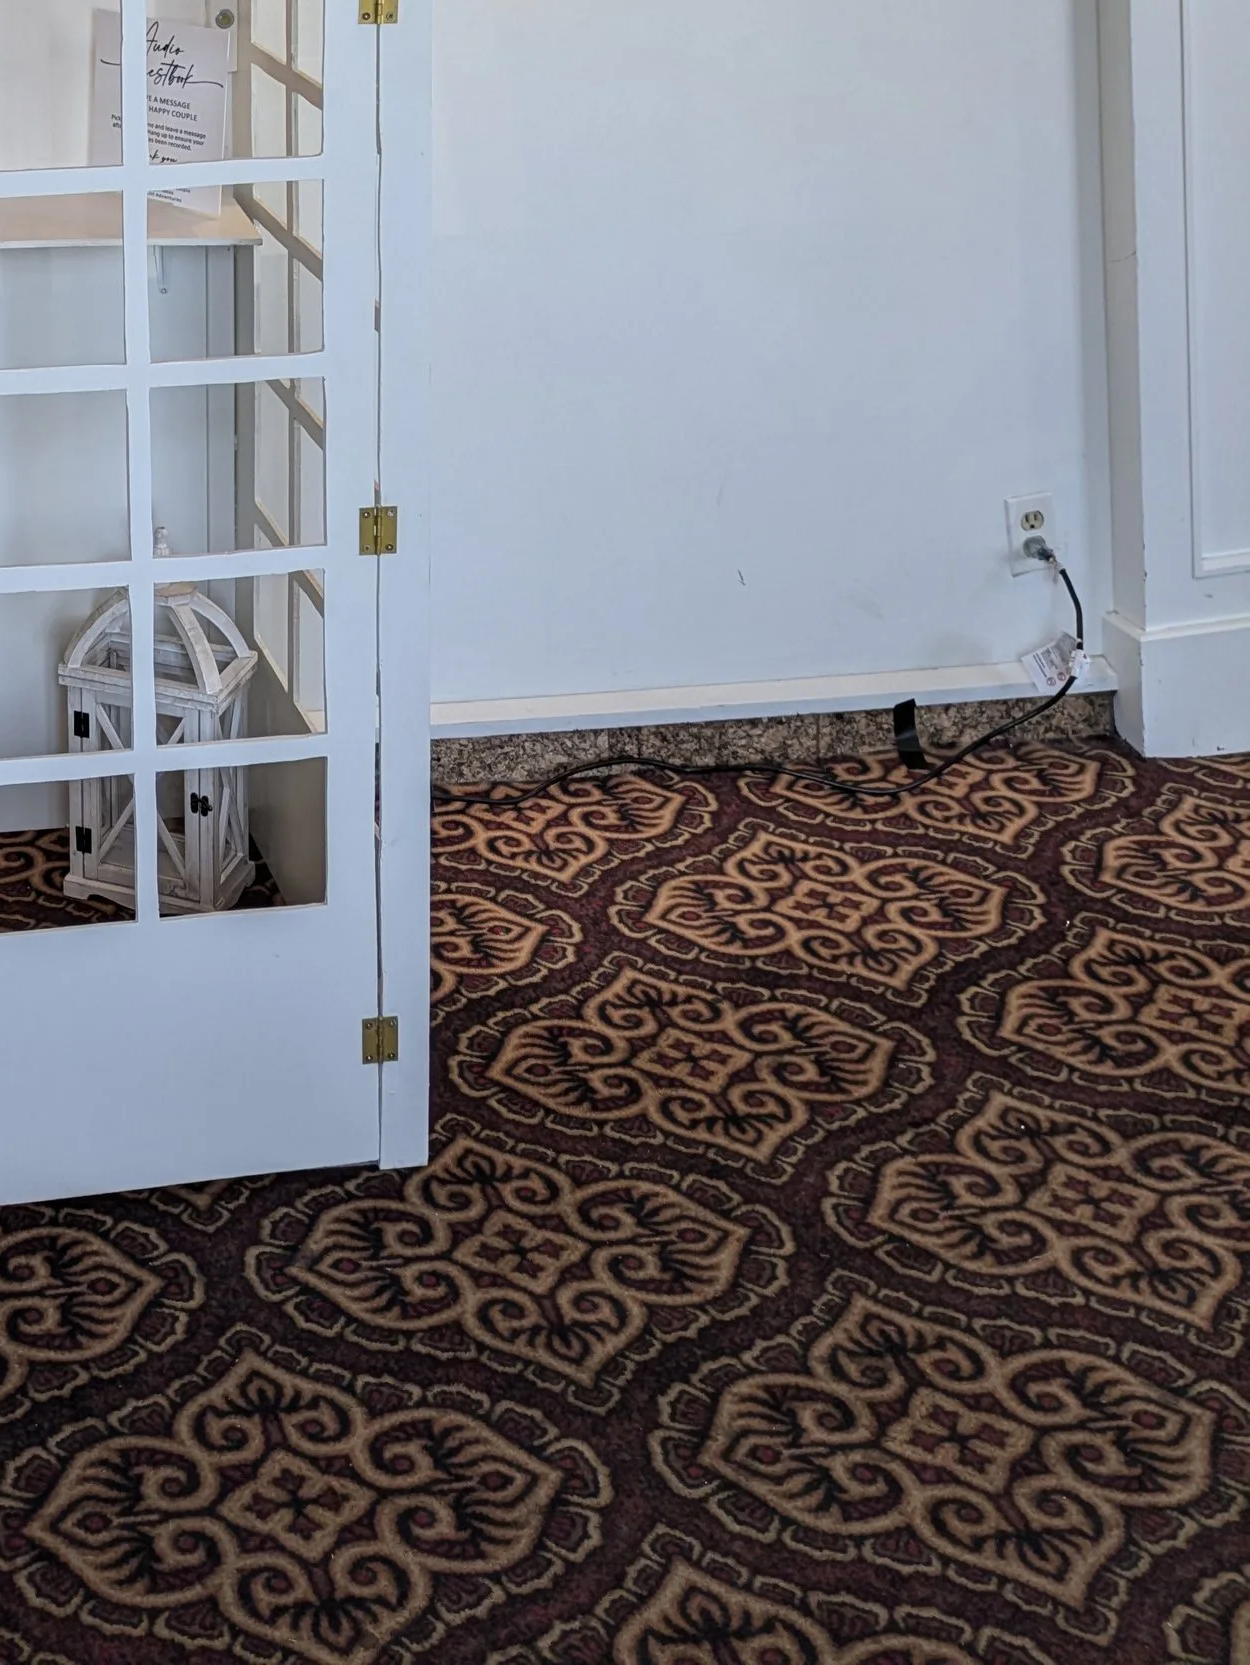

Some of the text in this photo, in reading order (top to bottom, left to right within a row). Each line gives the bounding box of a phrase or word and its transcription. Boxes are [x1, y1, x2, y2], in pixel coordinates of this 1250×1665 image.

[160, 97, 191, 109] MESSAGE
[148, 106, 198, 121] HAPPY COUPLE
[183, 130, 206, 140] message
